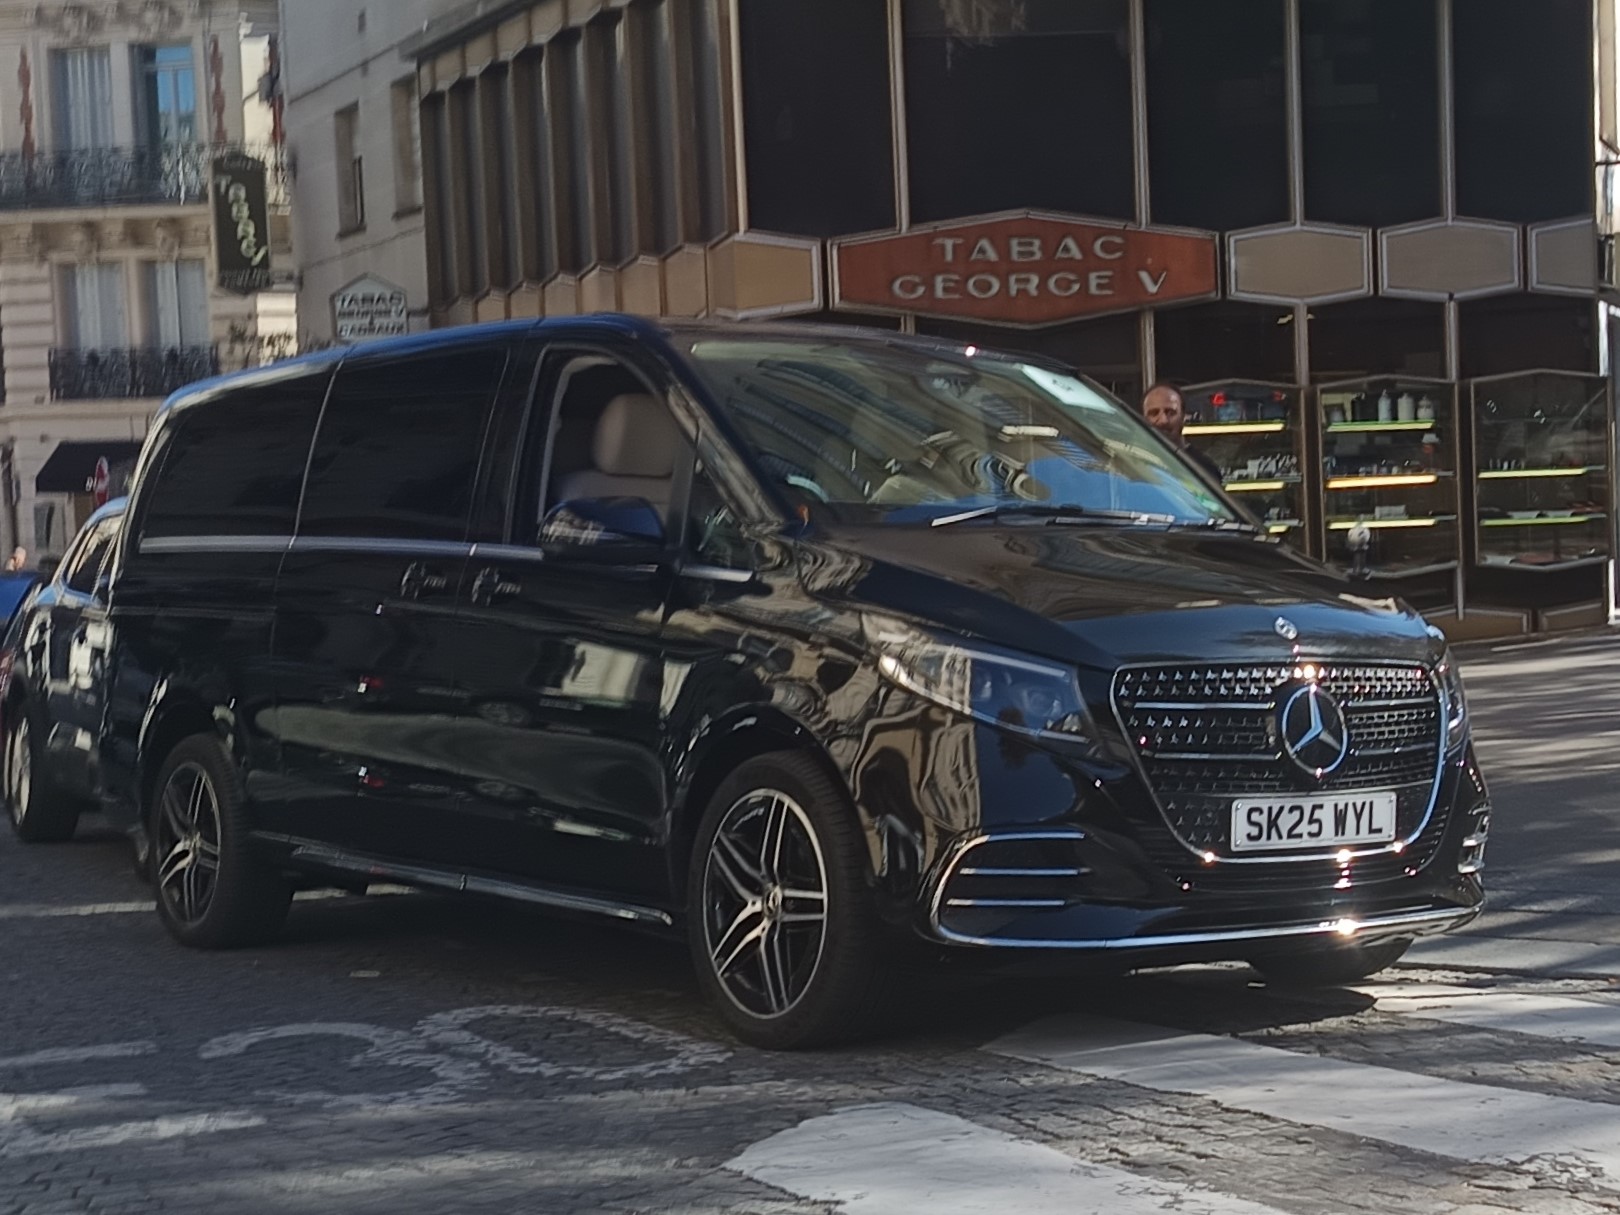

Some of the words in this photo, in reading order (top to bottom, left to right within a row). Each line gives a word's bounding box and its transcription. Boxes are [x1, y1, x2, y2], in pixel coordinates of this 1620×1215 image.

[933, 236, 1125, 263] TABAC
[891, 271, 1113, 299] GEORGE
[1138, 270, 1167, 295] V
[1246, 804, 1324, 841] SK25
[1333, 800, 1383, 837] WYL
